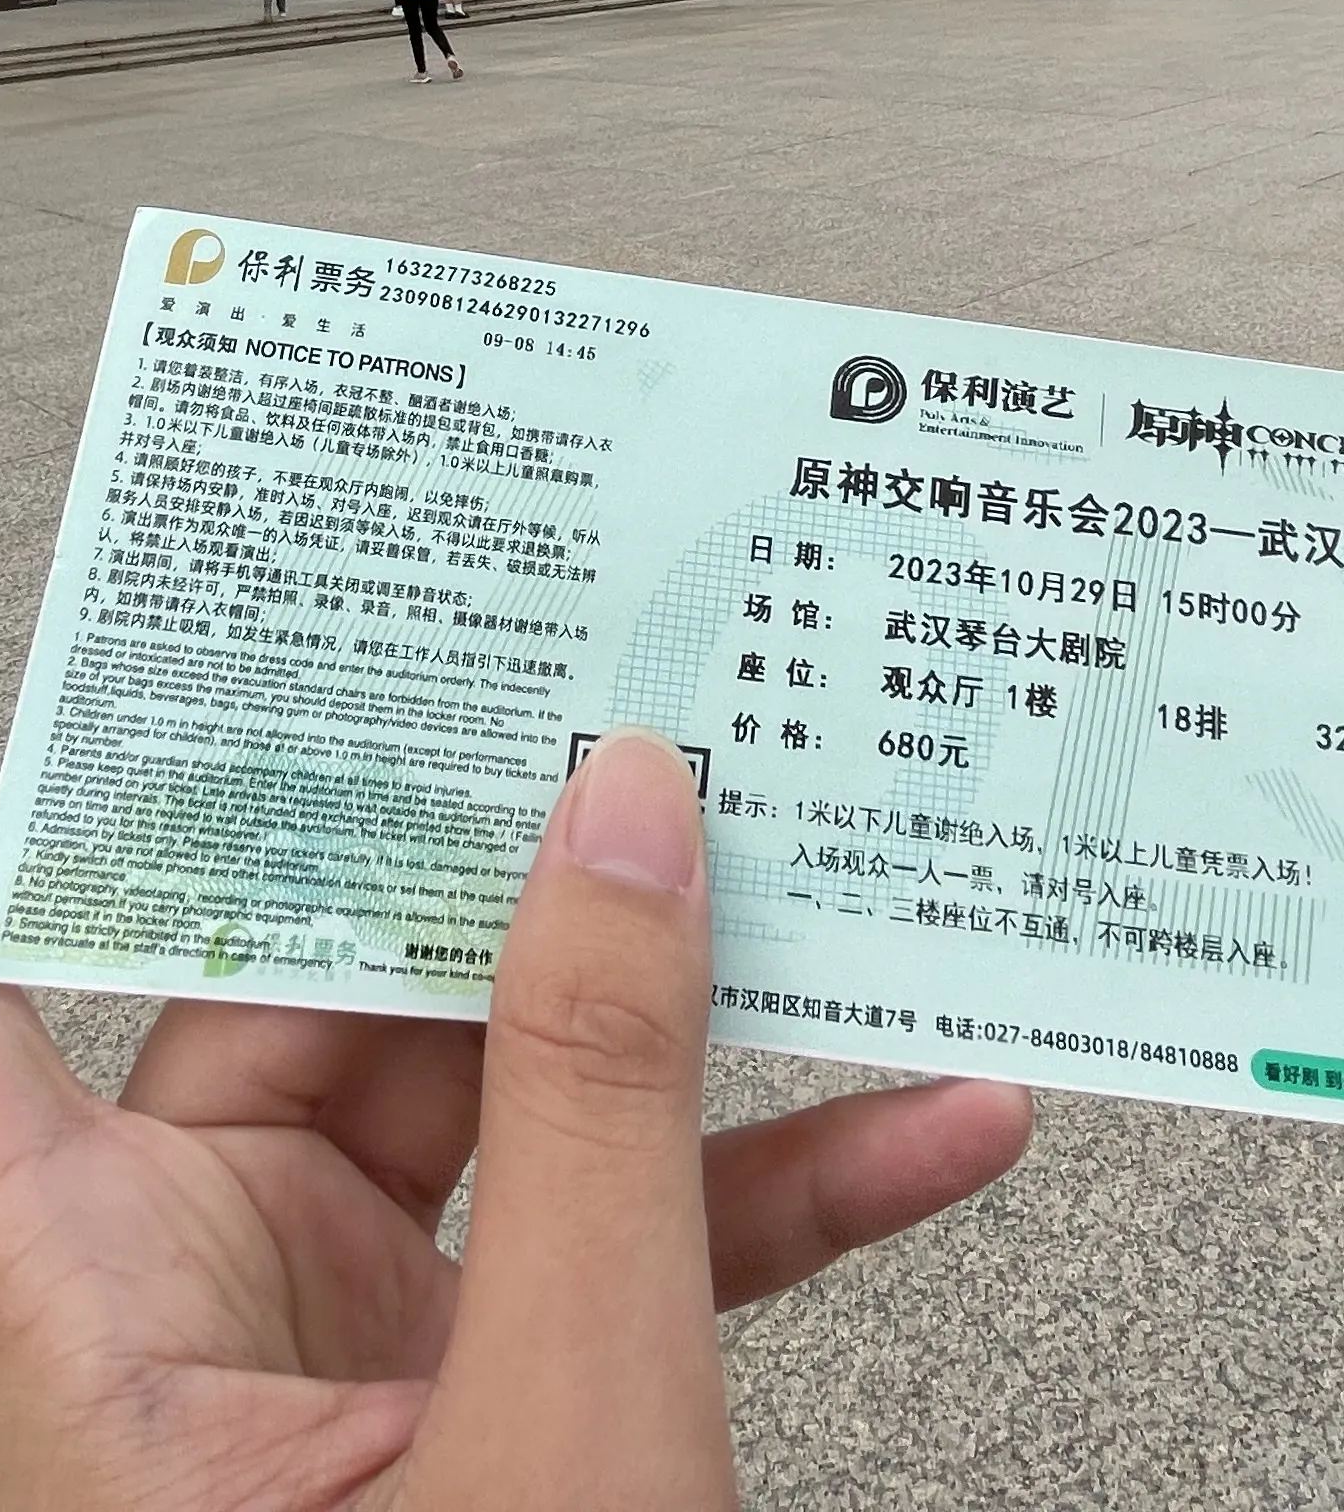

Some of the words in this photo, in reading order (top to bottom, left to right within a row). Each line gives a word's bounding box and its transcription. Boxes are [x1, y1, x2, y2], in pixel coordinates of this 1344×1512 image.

[233, 246, 379, 302] 保利票务
[384, 256, 557, 298] 16322773268225
[377, 284, 651, 340] 2309081246290132271296
[244, 337, 325, 367] NOTICE
[323, 347, 356, 371] TO
[481, 330, 536, 354] 09-08
[545, 339, 597, 362] 14:45
[919, 366, 1076, 422] 保利演艺
[950, 411, 977, 426] Arts
[918, 421, 1011, 444] Entertainment
[1015, 434, 1084, 454] Innovation
[887, 549, 1137, 614] 2023年10月29日
[1161, 583, 1302, 635] 15时00分
[69, 642, 113, 658] dressed
[114, 650, 126, 660] or
[127, 649, 185, 667] intoxicated
[186, 658, 204, 669] are
[206, 658, 224, 671] not
[225, 661, 236, 672] to
[237, 662, 252, 674] be
[85, 631, 128, 647] Patrons
[128, 639, 147, 649] are
[148, 639, 182, 654] asked
[182, 643, 194, 655] to
[195, 644, 238, 660] observe
[239, 650, 257, 662] the
[257, 652, 287, 666] dress
[288, 655, 314, 669] code
[316, 659, 337, 672] and
[337, 662, 365, 675] enter
[365, 665, 383, 677] the
[385, 667, 438, 684] auditorium
[479, 678, 499, 691] The
[499, 681, 551, 699] indecently
[882, 607, 1127, 672] 武汉琴台大剧院
[63, 667, 87, 680] size
[88, 669, 100, 682] of
[101, 673, 125, 687] your
[126, 674, 154, 690] bags
[155, 679, 193, 692] excess
[194, 682, 213, 694] the
[213, 684, 265, 703] maximum,
[269, 692, 290, 705] you
[291, 693, 326, 708] should
[327, 697, 366, 714] deposit
[367, 701, 394, 715] them
[395, 705, 405, 717] in
[406, 706, 424, 719] the
[425, 708, 456, 723] locker
[489, 716, 505, 728] No
[79, 656, 108, 672] Bags
[110, 660, 145, 674] whose
[147, 664, 169, 677] size
[170, 667, 210, 682] exceed
[210, 671, 229, 684] the
[229, 673, 287, 690] evacuation
[288, 680, 334, 696] standard
[334, 685, 367, 700] chairs
[368, 691, 385, 702] are
[387, 691, 435, 708] forbidden
[436, 697, 460, 710] from
[461, 700, 478, 713] the
[537, 709, 545, 720] If
[546, 710, 563, 722] the
[879, 664, 985, 711] 观众厅
[1006, 679, 1058, 721] 1楼
[1158, 699, 1228, 742] 18排
[877, 726, 971, 770] 680元
[357, 959, 389, 975] Thank
[388, 964, 408, 978] you
[408, 964, 423, 977] for
[423, 968, 447, 982] your
[448, 967, 471, 982] kind
[403, 940, 494, 969] 谢谢您的合作
[709, 983, 918, 1034] 市汉阳区知音大道7号
